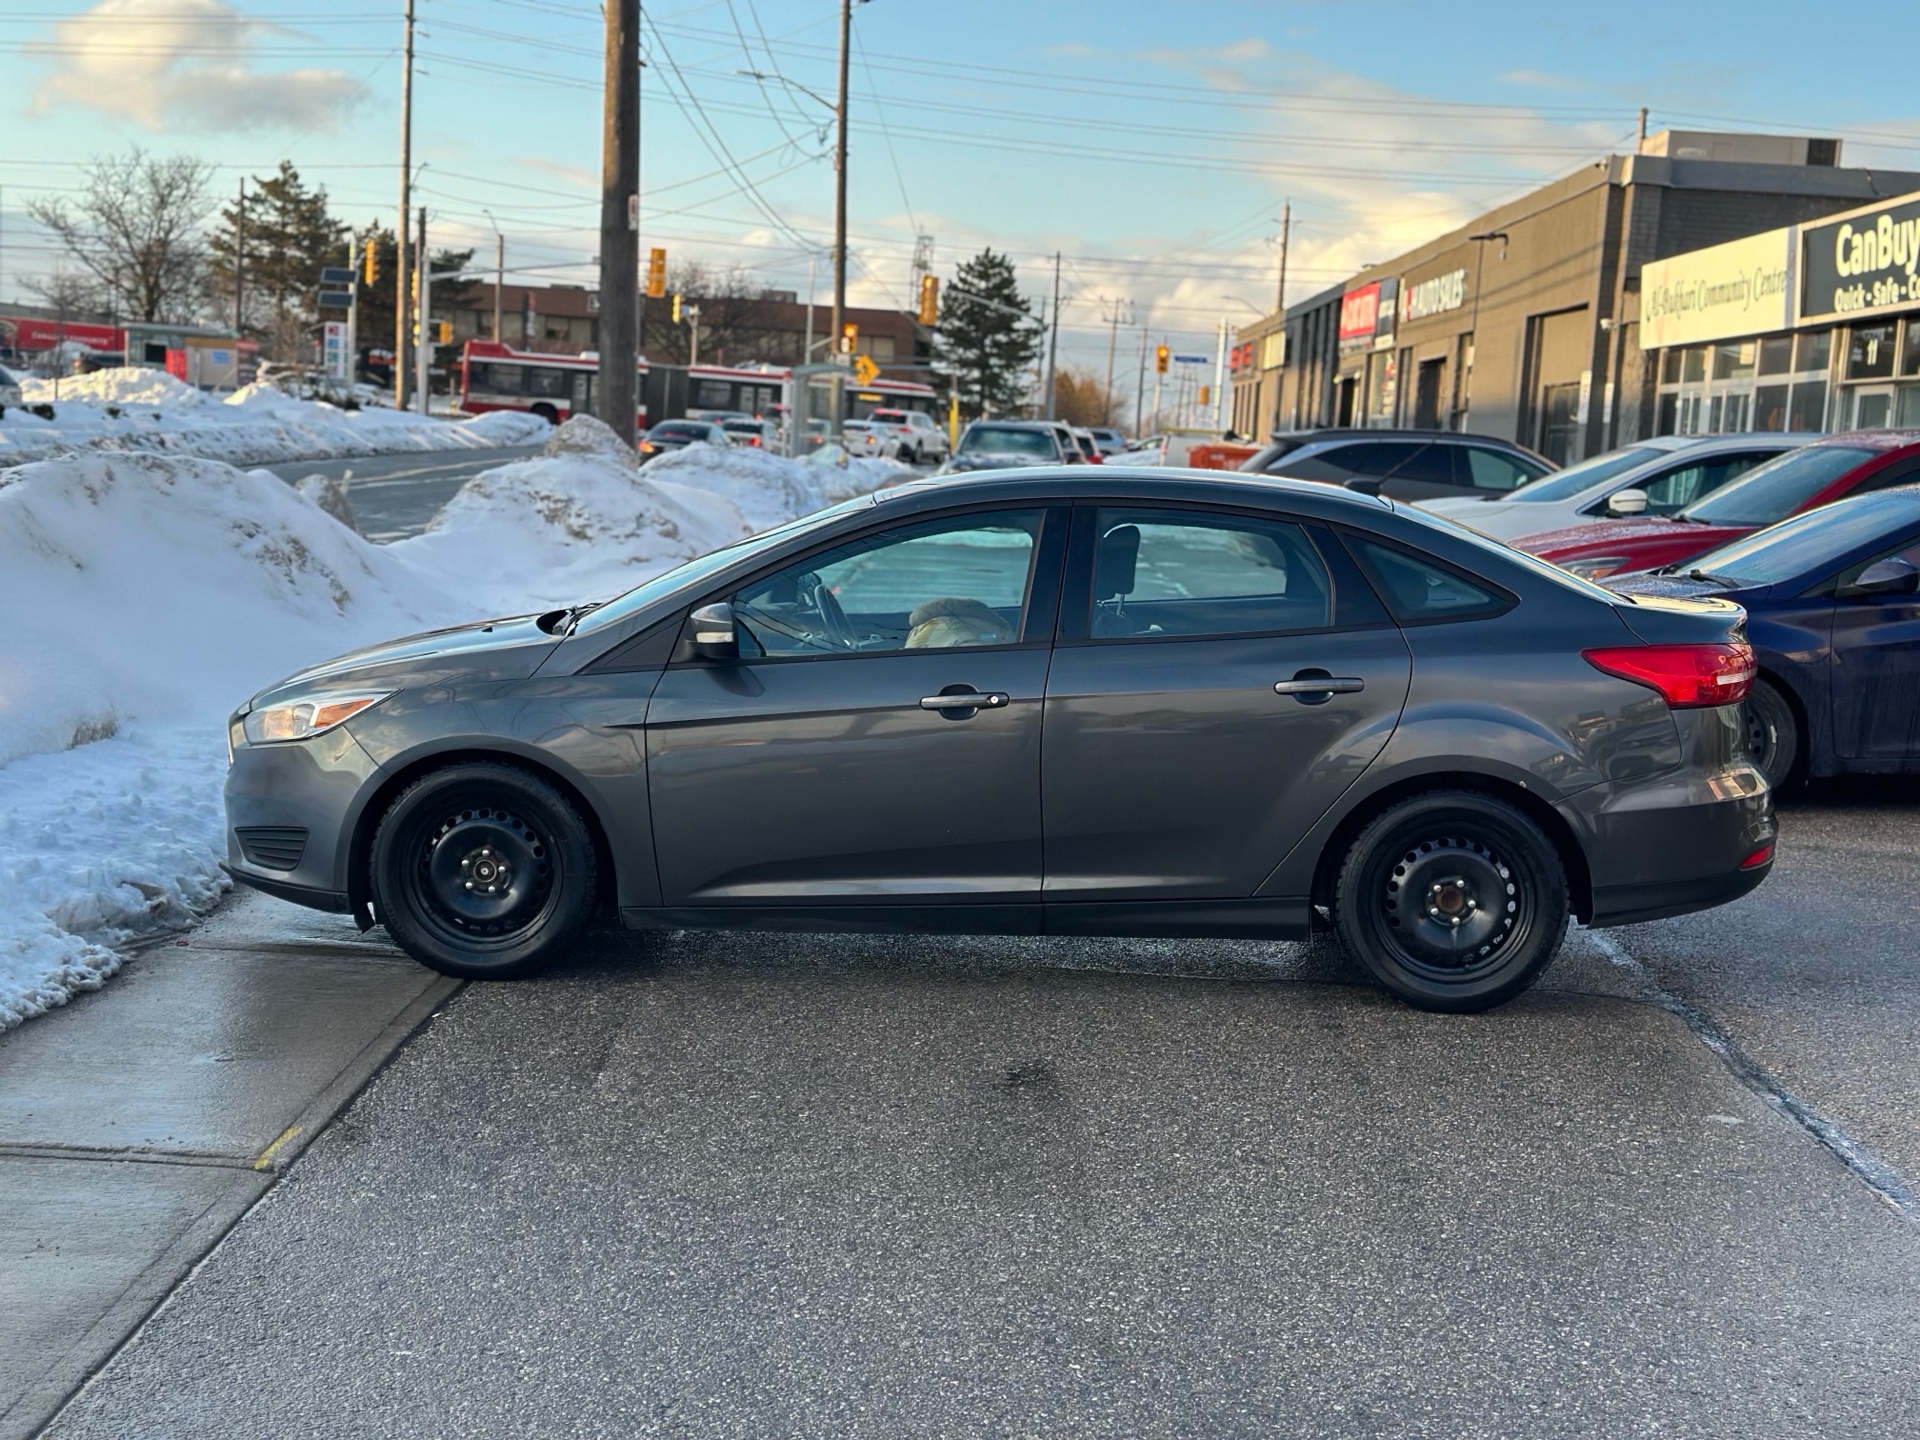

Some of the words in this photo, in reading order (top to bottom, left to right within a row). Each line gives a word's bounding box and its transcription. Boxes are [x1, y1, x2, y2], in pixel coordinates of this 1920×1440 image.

[1836, 214, 1920, 277] CanBuy
[1438, 269, 1465, 313] SALES
[1698, 270, 1751, 312] Community
[1834, 282, 1866, 314] Quick
[1872, 276, 1899, 306] Safe
[1867, 338, 1878, 366] 11
